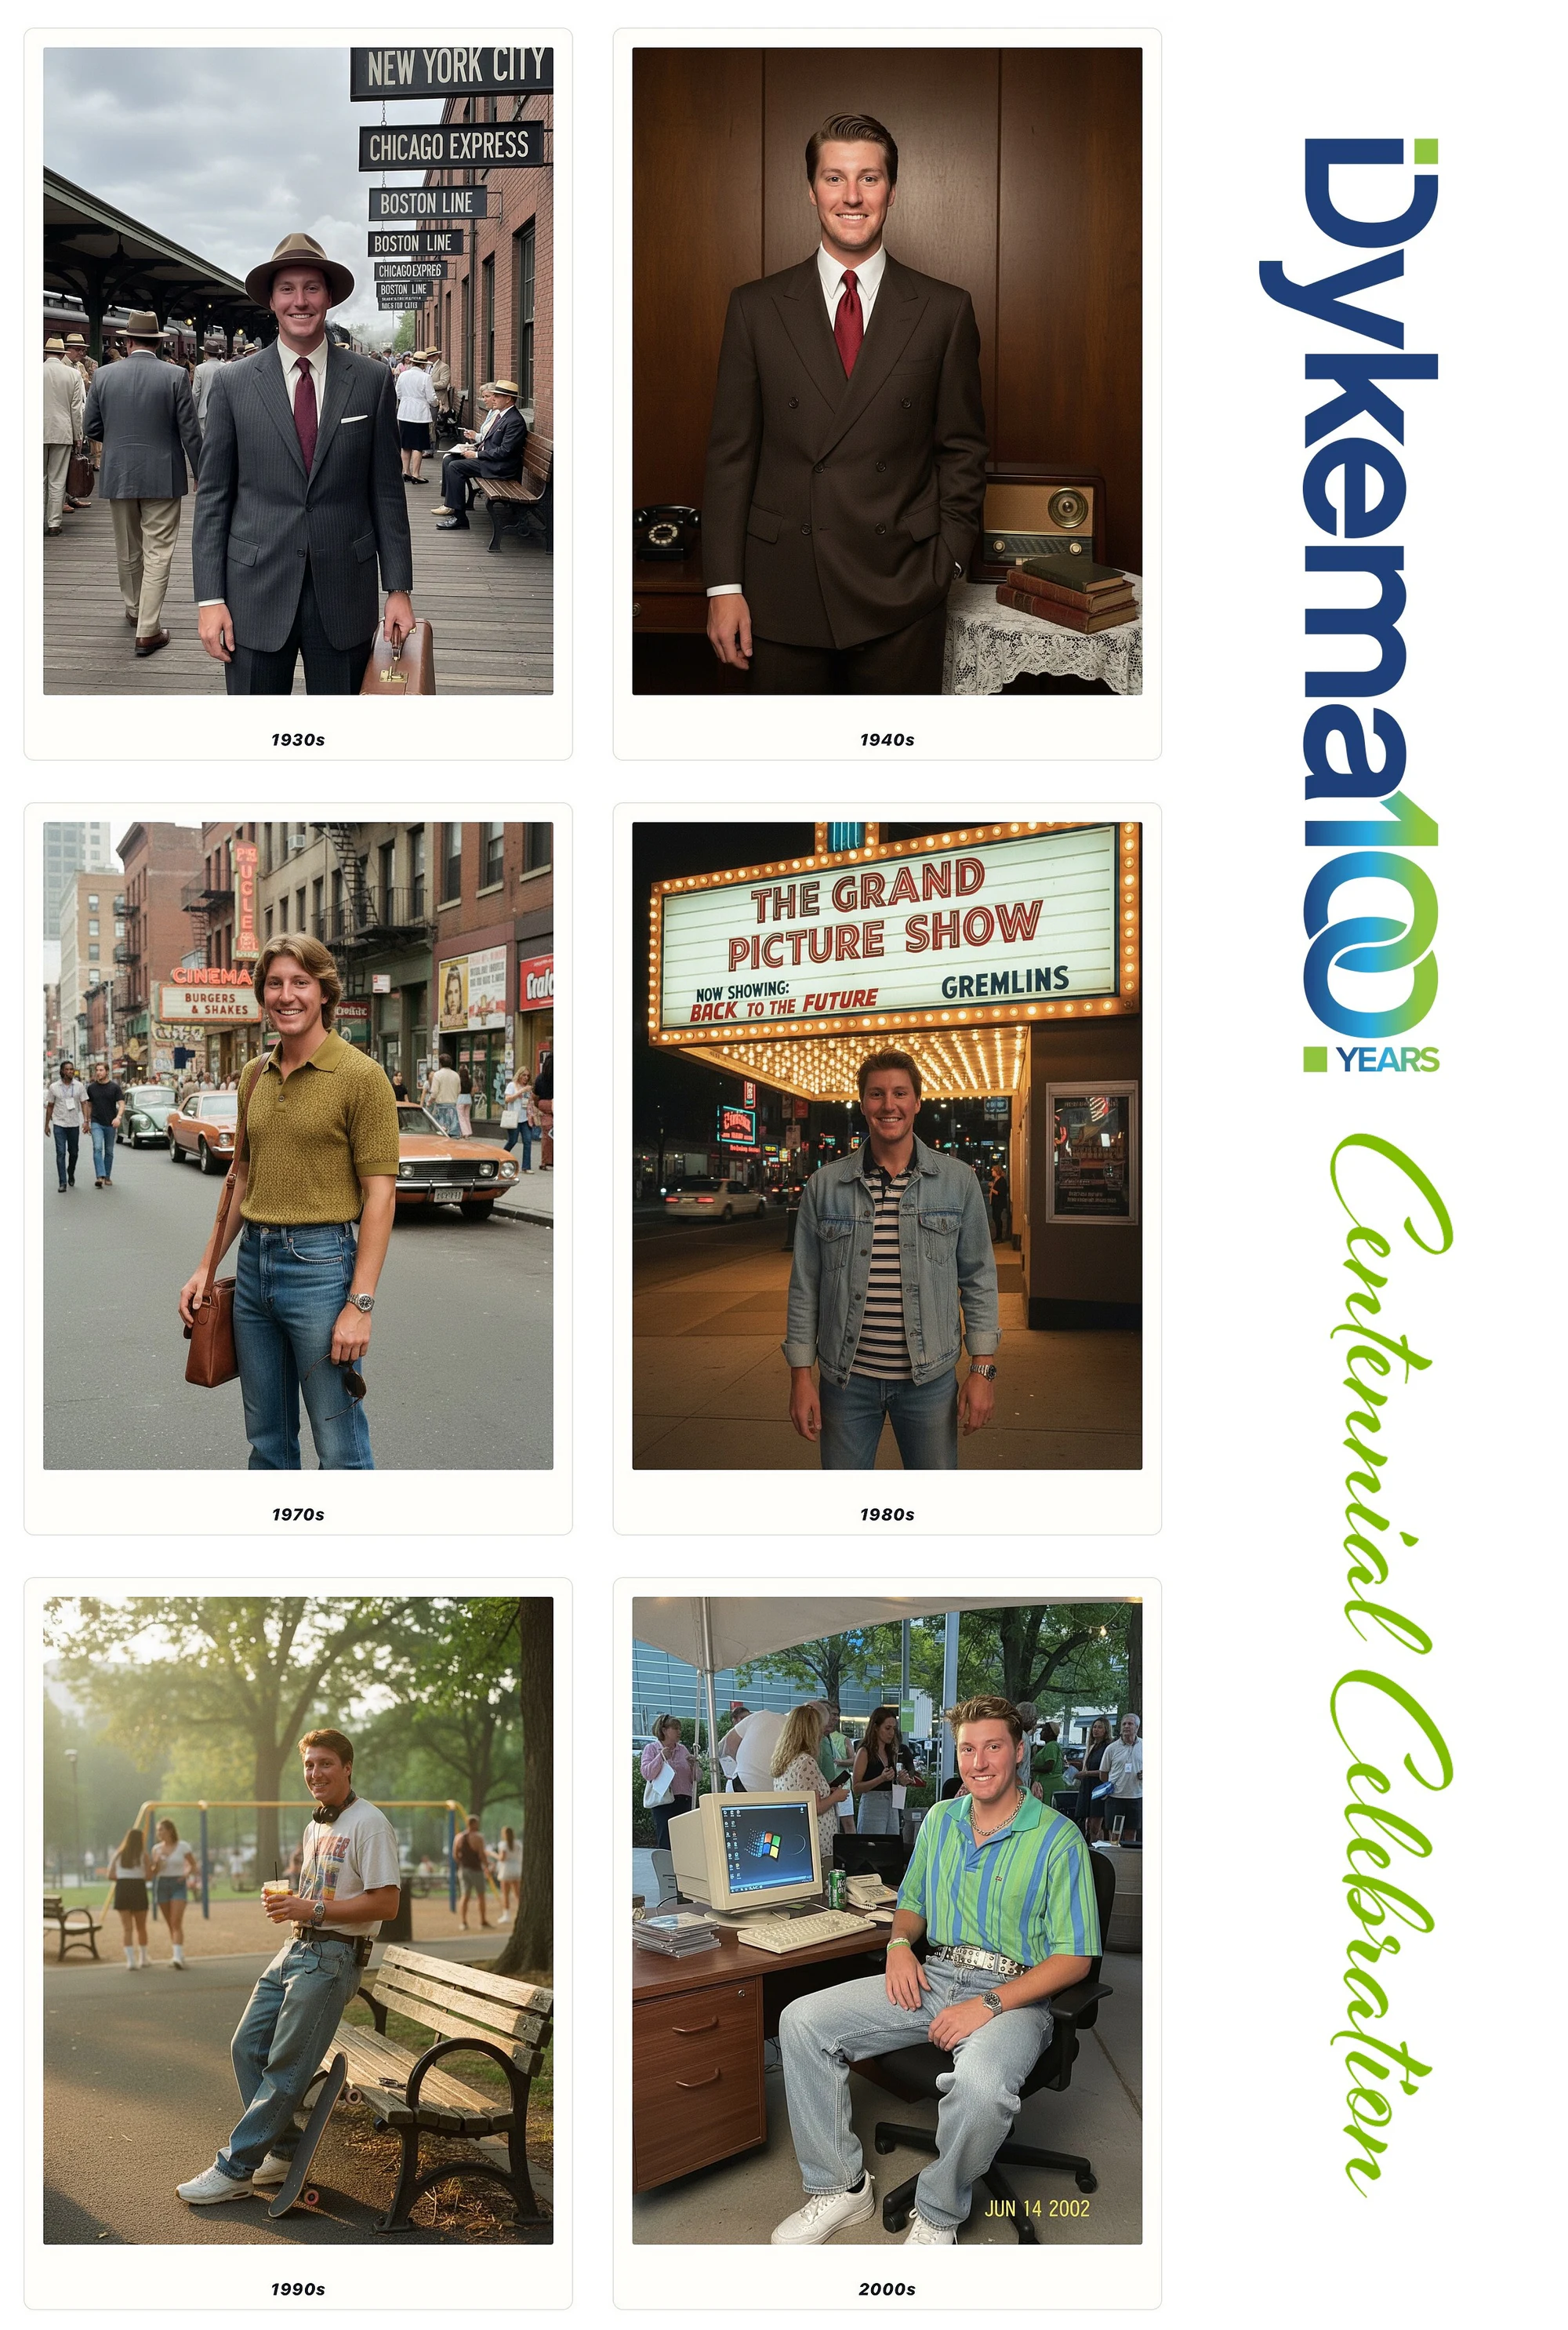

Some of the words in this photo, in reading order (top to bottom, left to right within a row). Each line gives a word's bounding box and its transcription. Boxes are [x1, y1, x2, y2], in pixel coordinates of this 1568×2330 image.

[368, 50, 416, 85] NEW
[423, 48, 483, 83] YORK
[493, 48, 546, 82] CITY
[370, 133, 444, 162] CHICAGO
[449, 130, 528, 159] EXPRESS
[380, 192, 436, 214] BOSTON
[442, 191, 473, 213] LINE
[374, 234, 419, 253] BOSTON
[426, 234, 452, 251] LINE
[380, 284, 408, 295] BOSTON
[412, 283, 427, 294] LINE
[750, 880, 820, 924] THE
[831, 856, 985, 913] GRAND
[728, 919, 885, 972] PICTURE
[905, 900, 1044, 954] SHOW
[172, 967, 253, 985] CINEMA
[942, 965, 1069, 999] GREMLINS
[185, 993, 235, 1003] BURGERS
[689, 1001, 739, 1023] BACK
[747, 1001, 764, 1017] TO
[769, 998, 797, 1015] THE
[802, 987, 880, 1012] FUTURE
[696, 986, 724, 1003] NOW
[728, 980, 789, 1000] SHOWING:
[191, 1005, 198, 1014] &
[205, 1005, 248, 1015] SHAKES
[1335, 1046, 1440, 1073] YEARS
[1330, 1133, 1454, 1655] Centennial
[1330, 1669, 1454, 2198] Celebration
